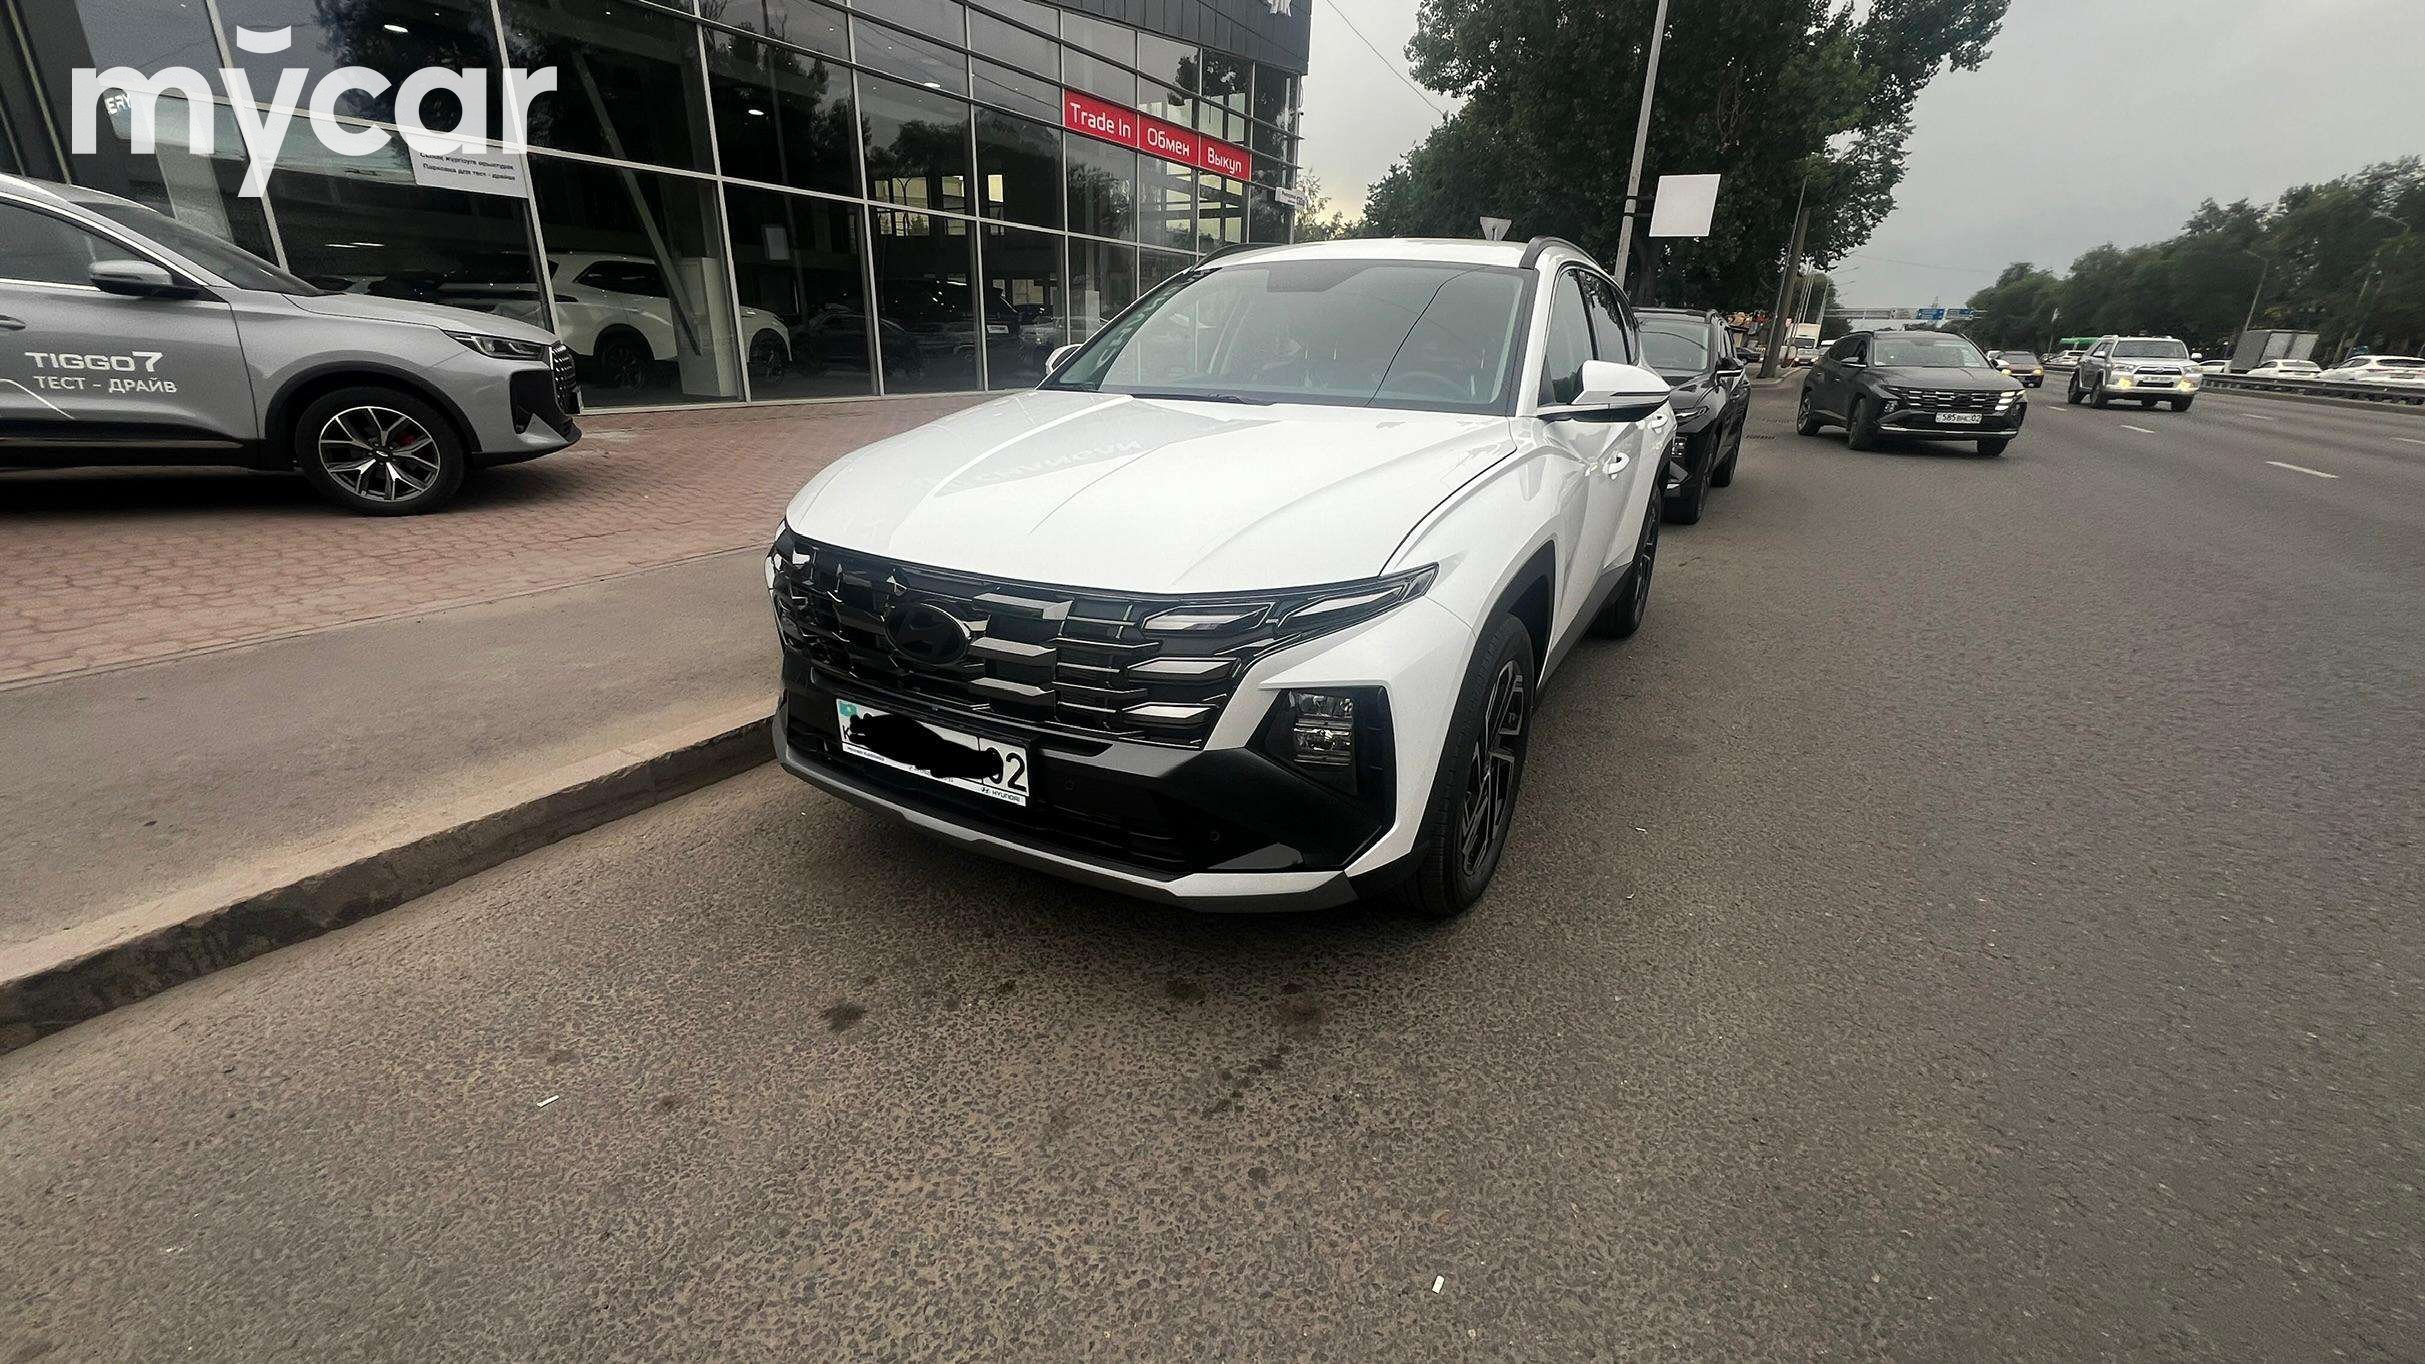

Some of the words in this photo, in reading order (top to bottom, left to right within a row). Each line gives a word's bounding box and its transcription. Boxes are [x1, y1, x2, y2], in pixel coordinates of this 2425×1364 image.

[1070, 102, 1115, 132] Trade
[1119, 118, 1131, 138] In
[1147, 127, 1190, 157] Обмен
[1207, 146, 1242, 174] Выкуп
[33, 375, 86, 391] ТЕСТ
[108, 376, 178, 394] ДРАЙВ
